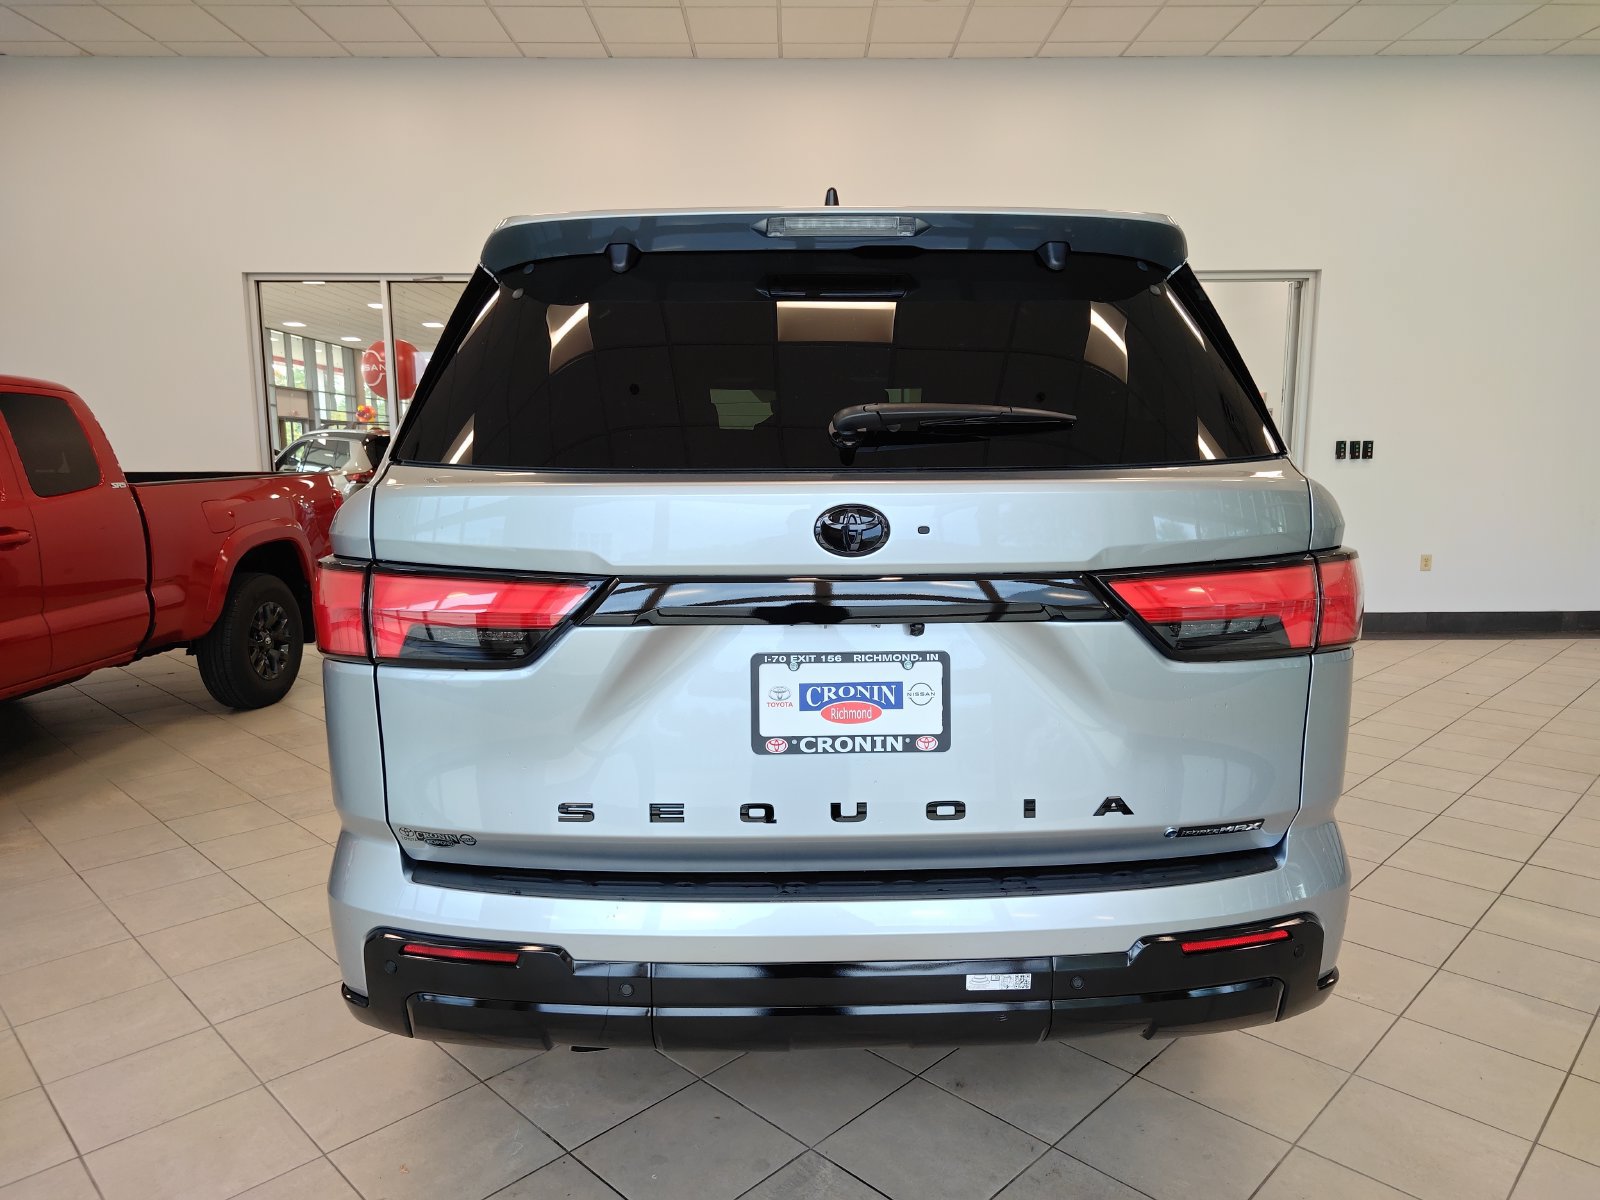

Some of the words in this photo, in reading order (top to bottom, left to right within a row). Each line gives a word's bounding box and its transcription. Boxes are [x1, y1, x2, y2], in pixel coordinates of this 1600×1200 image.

[764, 655, 787, 663] I-70
[790, 655, 816, 663] EXIT
[853, 654, 922, 662] RICHMOND,
[926, 653, 939, 661] IN
[806, 684, 897, 706] CRONIN
[830, 707, 872, 720] Richmond
[799, 736, 903, 753] CRONIN
[558, 796, 1134, 823] SEQUOIA
